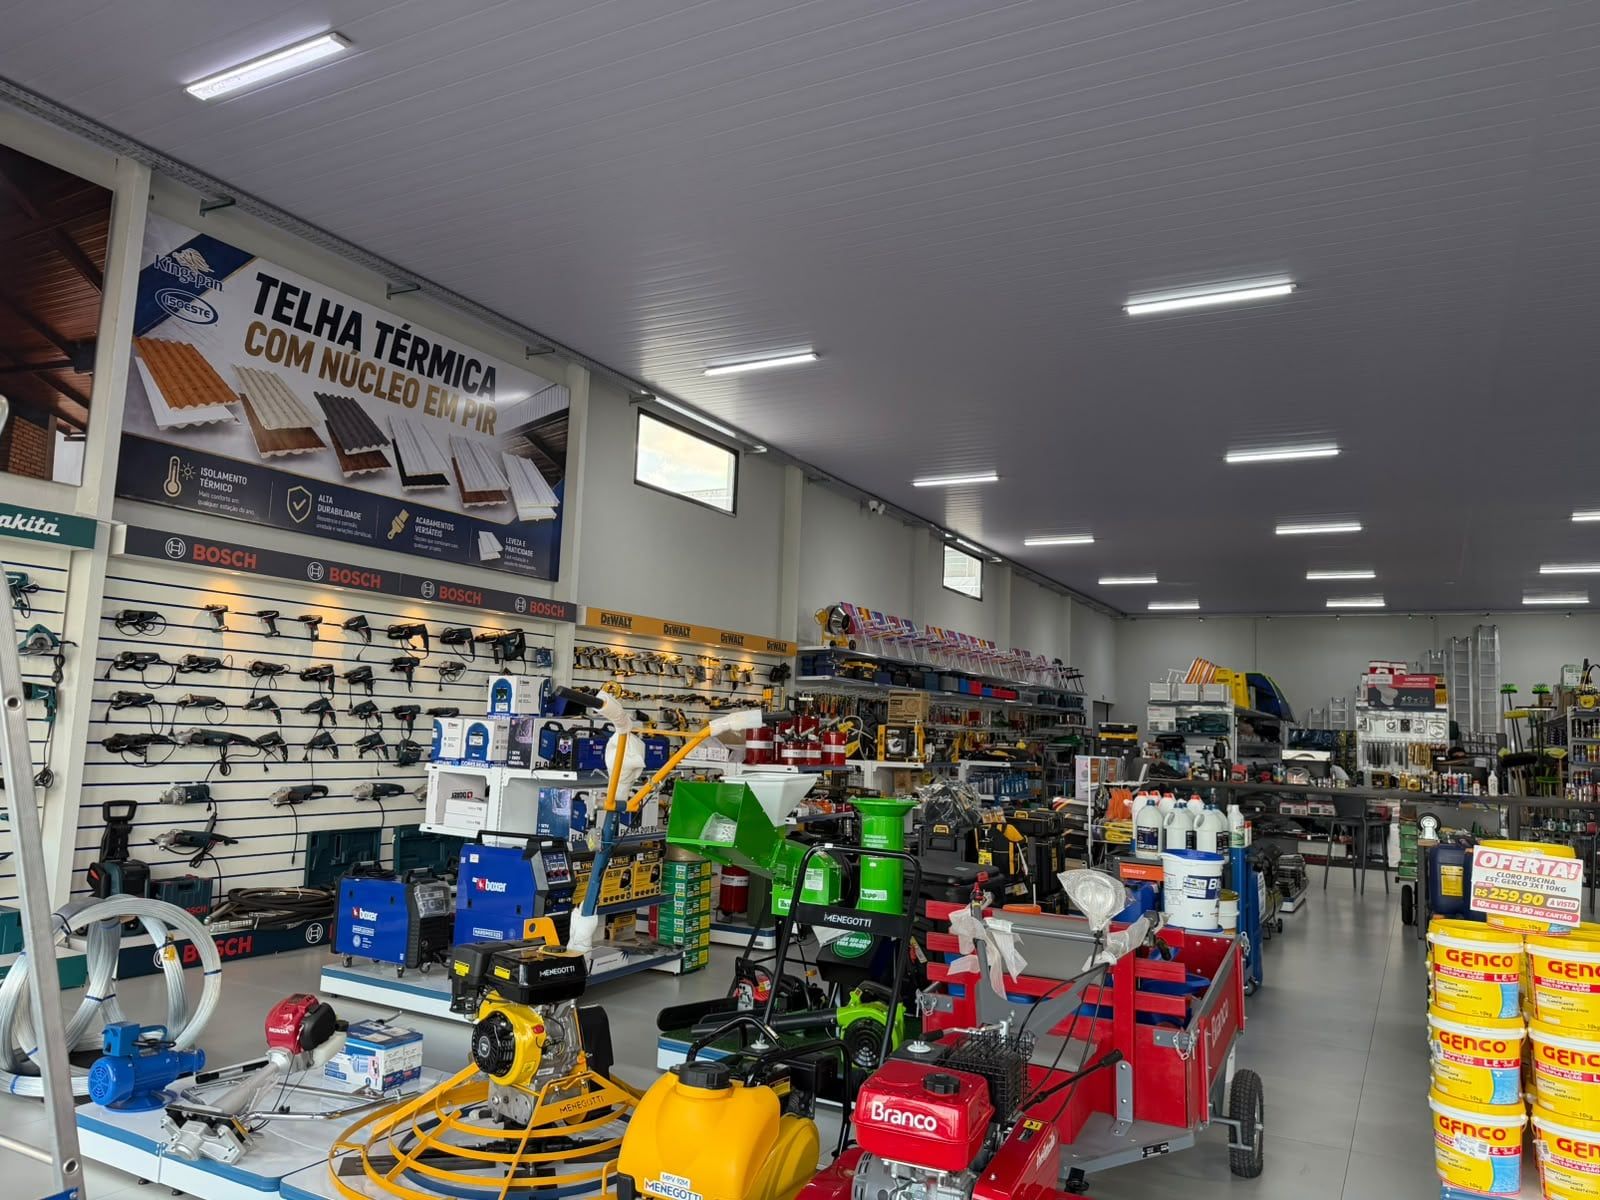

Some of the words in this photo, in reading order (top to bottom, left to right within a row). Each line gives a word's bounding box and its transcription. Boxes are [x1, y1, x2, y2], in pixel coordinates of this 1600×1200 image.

[154, 254, 224, 292] Kingspan
[164, 294, 211, 319] ISOESTE
[253, 272, 363, 352] TELHA
[373, 319, 497, 403] TÉRMICA
[244, 321, 316, 374] COM
[318, 346, 420, 409] NÚCLEO
[423, 383, 458, 424] EM
[461, 400, 498, 436] PIR
[199, 477, 233, 493] TÉRMICO
[200, 467, 248, 485] ISOLAMENTO
[317, 494, 333, 504] ALTA
[317, 504, 362, 521] DURABILIDADE
[0, 512, 61, 537] akita
[414, 524, 443, 538] VERSÁTEIS
[415, 516, 455, 532] ACABAMENTOS
[192, 542, 257, 569] BOSCH
[329, 566, 383, 588] BOSCH
[439, 585, 483, 606] BOSCH
[529, 601, 565, 617] BOSCH
[1479, 852, 1579, 880] OFERTA!
[486, 879, 507, 893] boxer
[1485, 875, 1500, 883] EST.
[1501, 878, 1528, 887] GENCO
[1545, 884, 1567, 893] 10KG
[1496, 872, 1523, 881] CLORO
[1523, 875, 1556, 886] PISCINA
[1474, 888, 1488, 898] R$
[1488, 886, 1545, 906] 259,90
[1557, 899, 1576, 909] VISTA
[185, 905, 208, 914] OSCH
[1510, 904, 1533, 914] 28,90
[824, 912, 872, 928] MENEGOTTI
[183, 935, 254, 964] BSCH
[1446, 949, 1513, 968] GENCO
[539, 965, 576, 977] MENEGOTTI
[1547, 960, 1600, 979] GEN
[1439, 1030, 1506, 1053] GENCO
[1542, 1045, 1600, 1068] GENC
[559, 1095, 605, 1114] MENEGOTTI
[871, 1101, 938, 1132] Branco
[1439, 1115, 1506, 1141] GENCO
[1556, 1137, 1600, 1160] GEN
